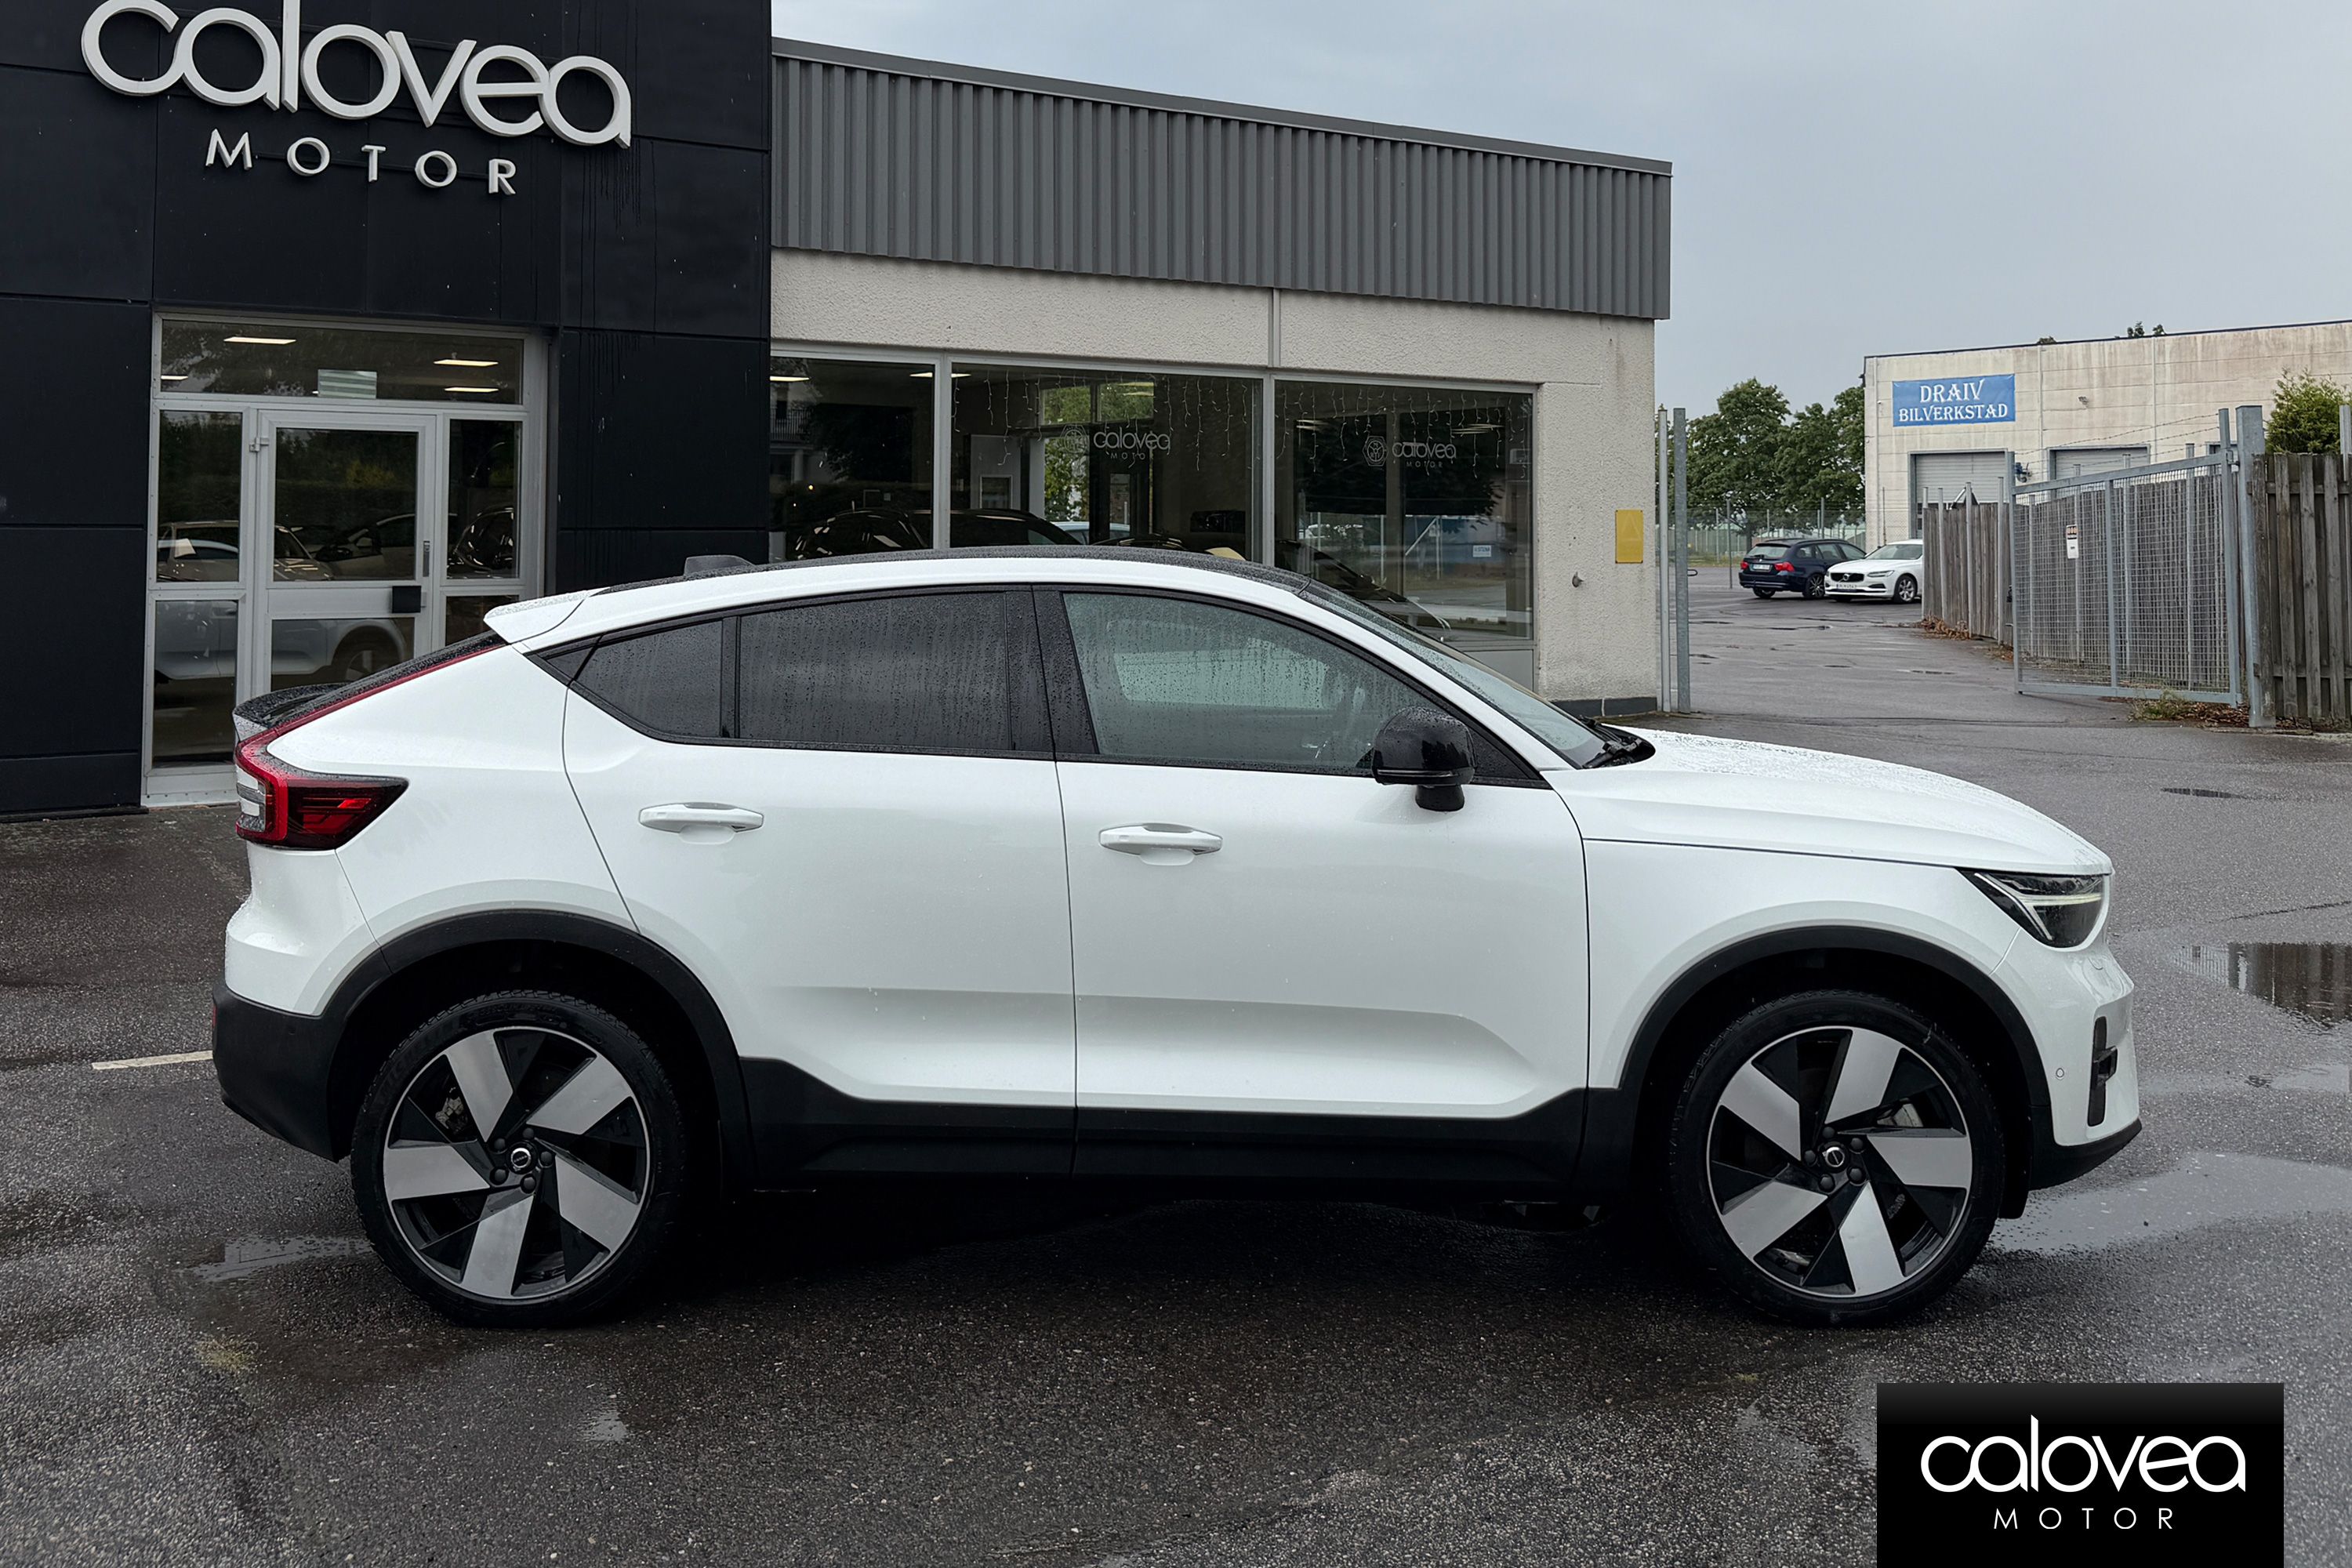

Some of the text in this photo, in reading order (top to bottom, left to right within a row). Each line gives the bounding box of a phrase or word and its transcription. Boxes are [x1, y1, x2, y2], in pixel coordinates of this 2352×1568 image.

[82, 0, 632, 149] calovea
[205, 128, 517, 195] MOTOR
[1920, 379, 1986, 403] DRAIV
[1899, 404, 2008, 422] BILVERKSTAD
[1093, 426, 1171, 451] calovea
[1392, 441, 1457, 459] calovea
[1110, 452, 1153, 460] MOTO
